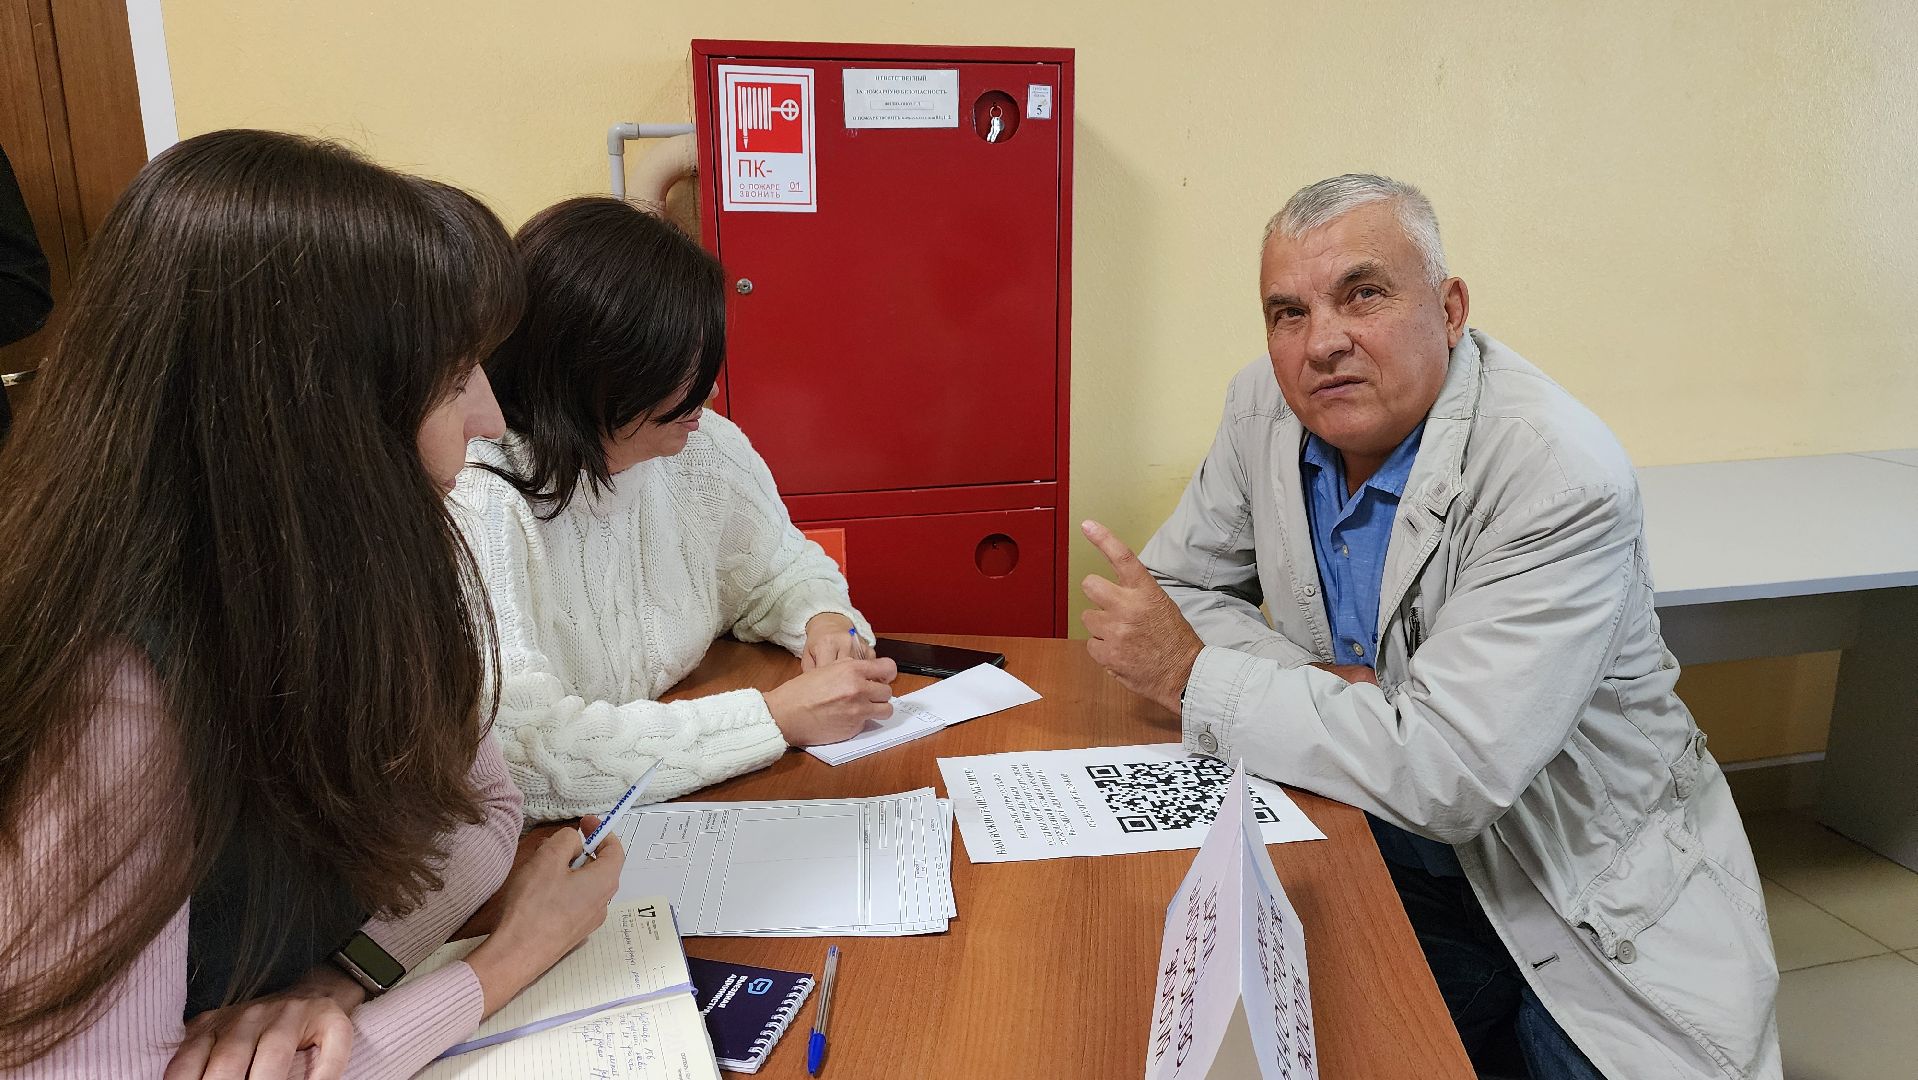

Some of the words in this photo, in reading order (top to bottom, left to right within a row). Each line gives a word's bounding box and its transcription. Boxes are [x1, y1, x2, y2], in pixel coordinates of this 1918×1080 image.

[1036, 104, 1043, 116] 5
[738, 160, 772, 177] ПК-
[748, 183, 780, 191] ПОЖАРЕ
[789, 181, 801, 190] 01
[610, 785, 636, 815] ЕДИНАЯ
[585, 816, 611, 845] РОССИЯ
[638, 904, 656, 918] 17
[1173, 876, 1202, 1078] БЛАГОУСТРОЙСТВО,
[718, 976, 748, 1008] ВЫЕЗДНАЯ
[1154, 948, 1180, 1066] ЭКОЛОГИЯ
[1290, 963, 1314, 1080] ЭКОЛОГИЯ
